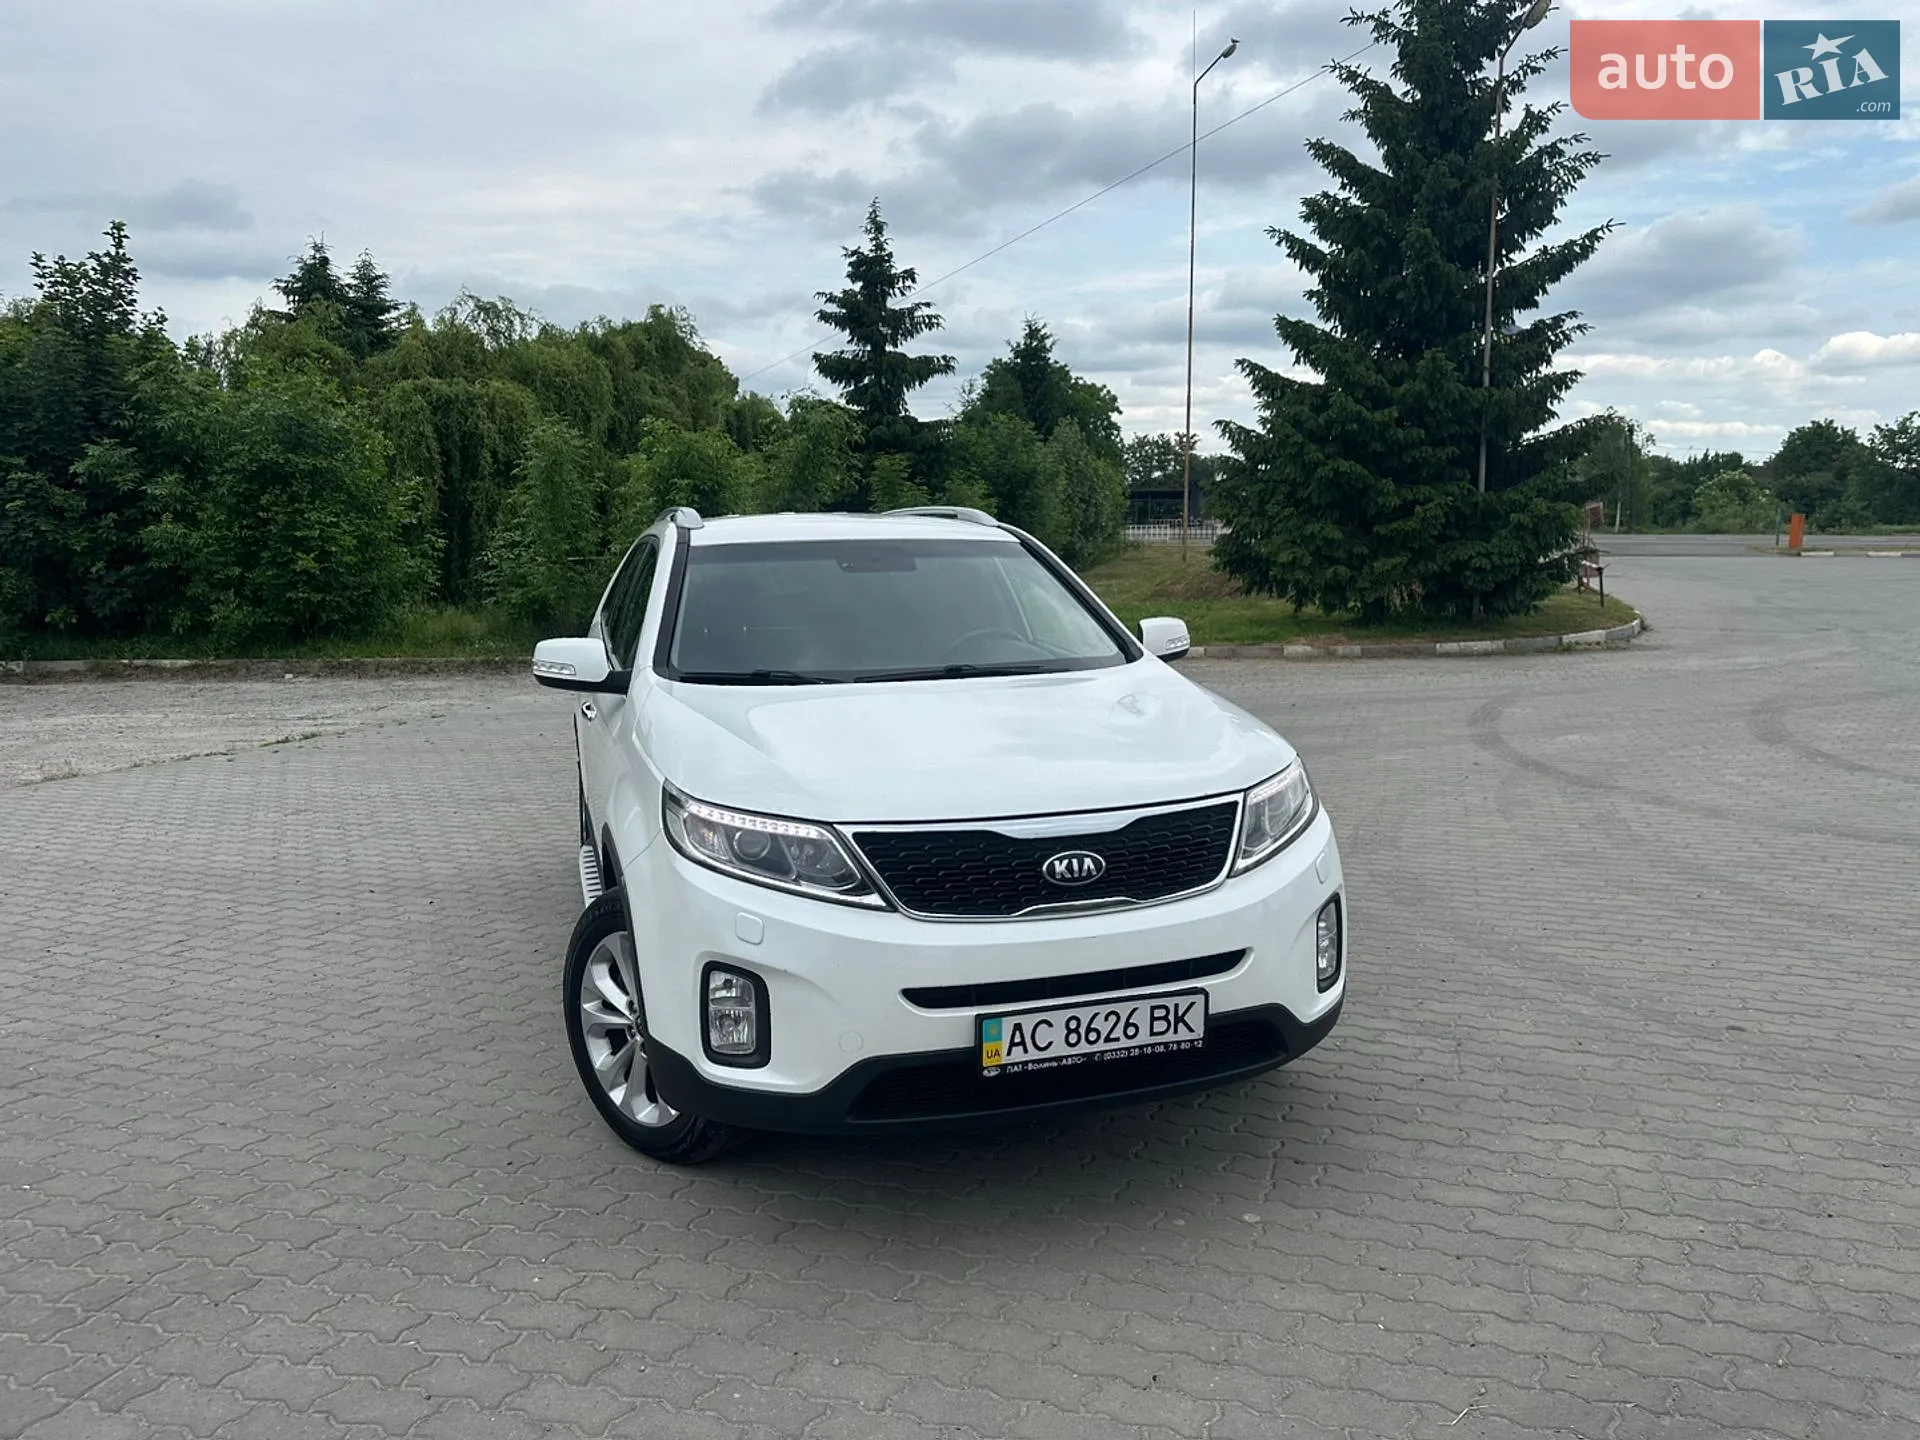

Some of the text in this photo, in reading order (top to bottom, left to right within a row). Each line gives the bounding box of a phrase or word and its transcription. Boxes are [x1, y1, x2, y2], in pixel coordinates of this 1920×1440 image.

[1053, 857, 1097, 879] KIA
[1006, 1001, 1197, 1057] AC 8626 BK
[986, 1050, 1001, 1060] UA
